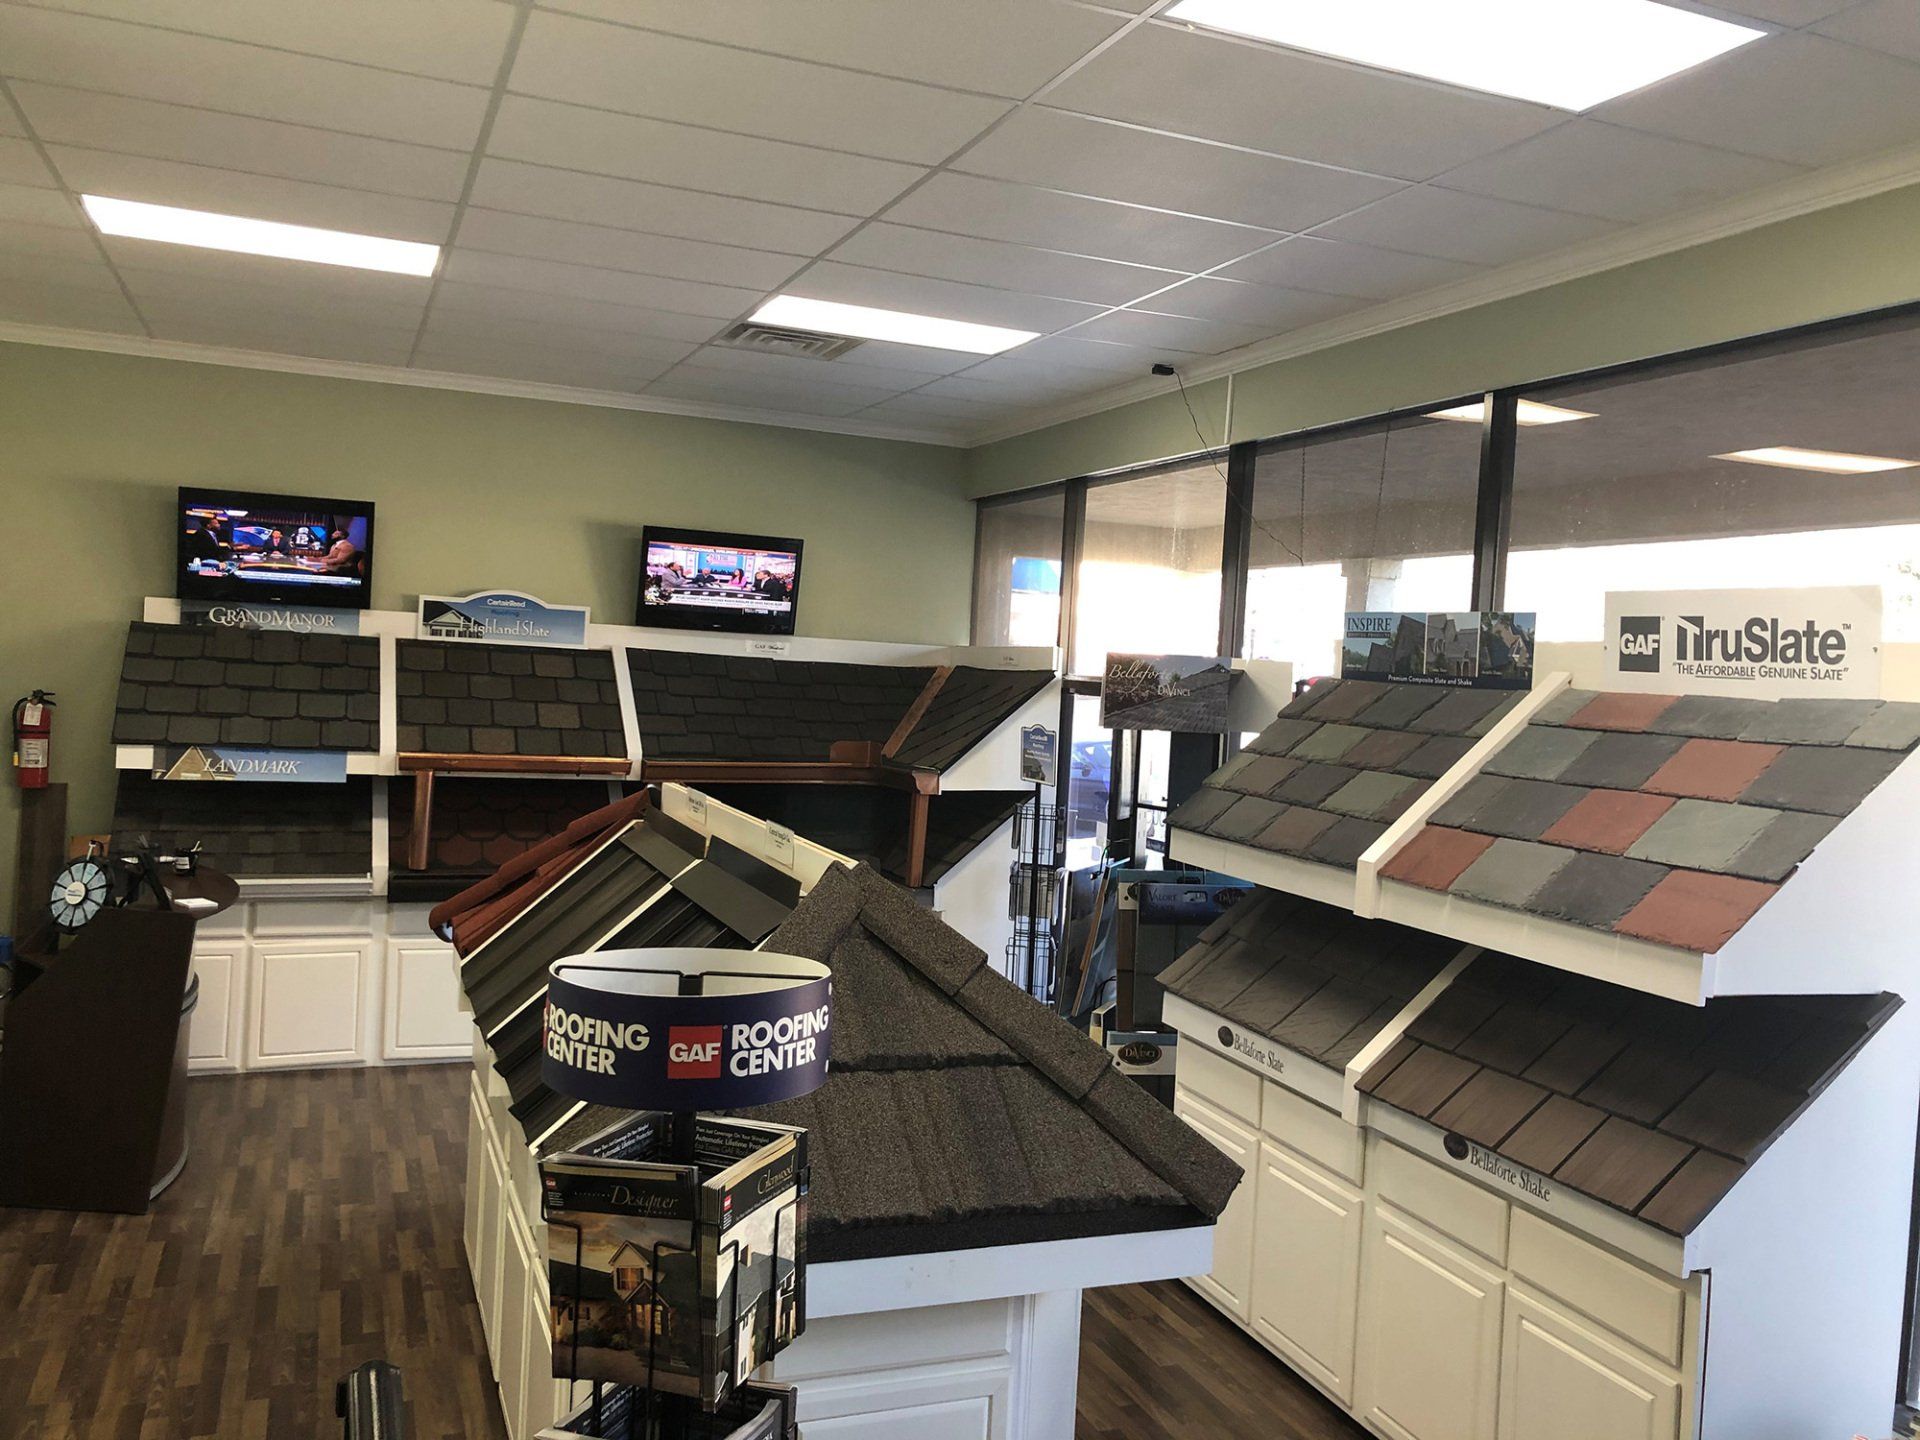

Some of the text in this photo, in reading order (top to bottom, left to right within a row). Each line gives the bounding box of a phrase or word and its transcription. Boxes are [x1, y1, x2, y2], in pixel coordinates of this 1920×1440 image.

[459, 616, 550, 639] Highland Slate
[1347, 617, 1392, 631] INSPIRE
[1619, 632, 1660, 656] GAF
[1695, 664, 1756, 678] AFFORDABLE
[1758, 665, 1807, 680] GENUINE
[202, 757, 302, 775] LANDMARK
[549, 1003, 650, 1052] ROOFING
[731, 1004, 829, 1051] ROOFING
[547, 1034, 617, 1076] CENTER
[668, 1041, 721, 1063] GAF
[729, 1037, 816, 1078] CENTER
[1470, 1145, 1552, 1202] Bellaforte Shake
[610, 1185, 679, 1213] Designer
